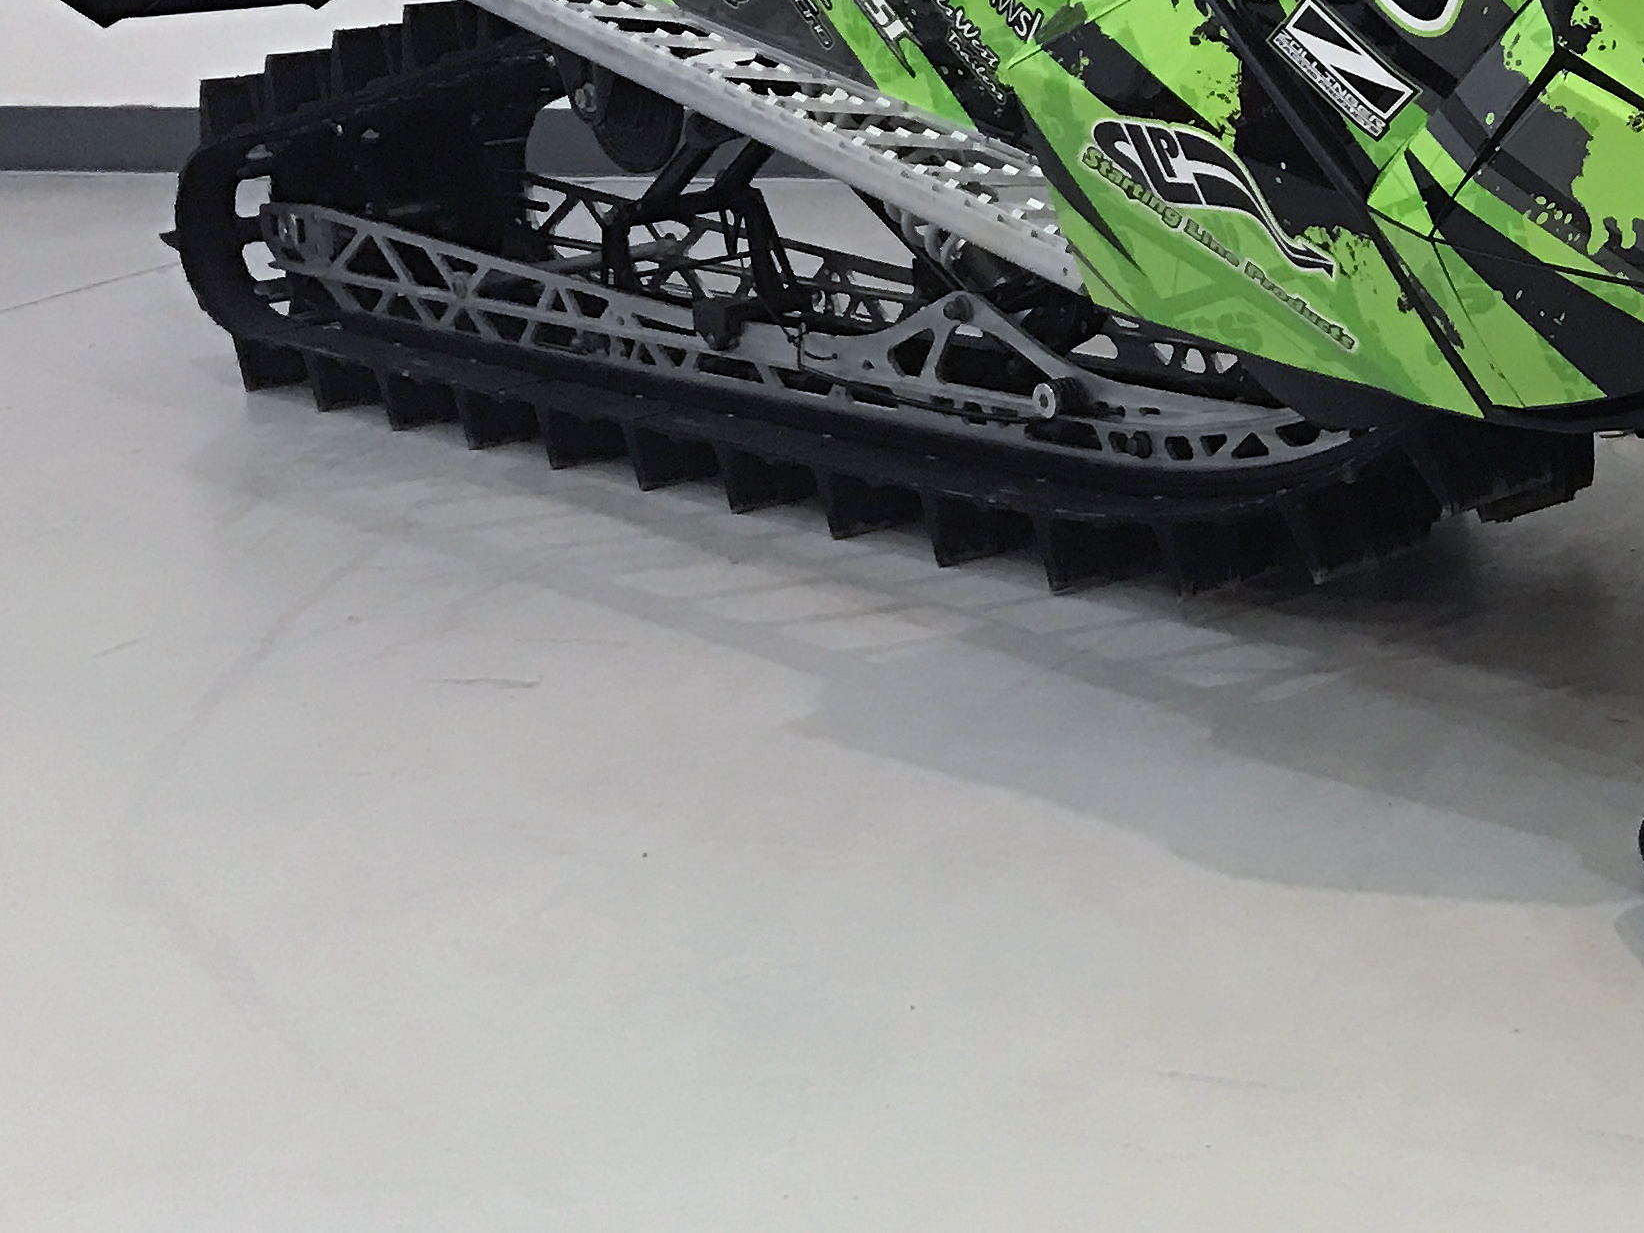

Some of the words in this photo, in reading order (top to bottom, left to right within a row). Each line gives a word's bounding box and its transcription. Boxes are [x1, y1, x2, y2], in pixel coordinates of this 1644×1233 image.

[1081, 145, 1183, 229] Starting
[1184, 218, 1240, 268] Line
[1244, 260, 1356, 351] Products
